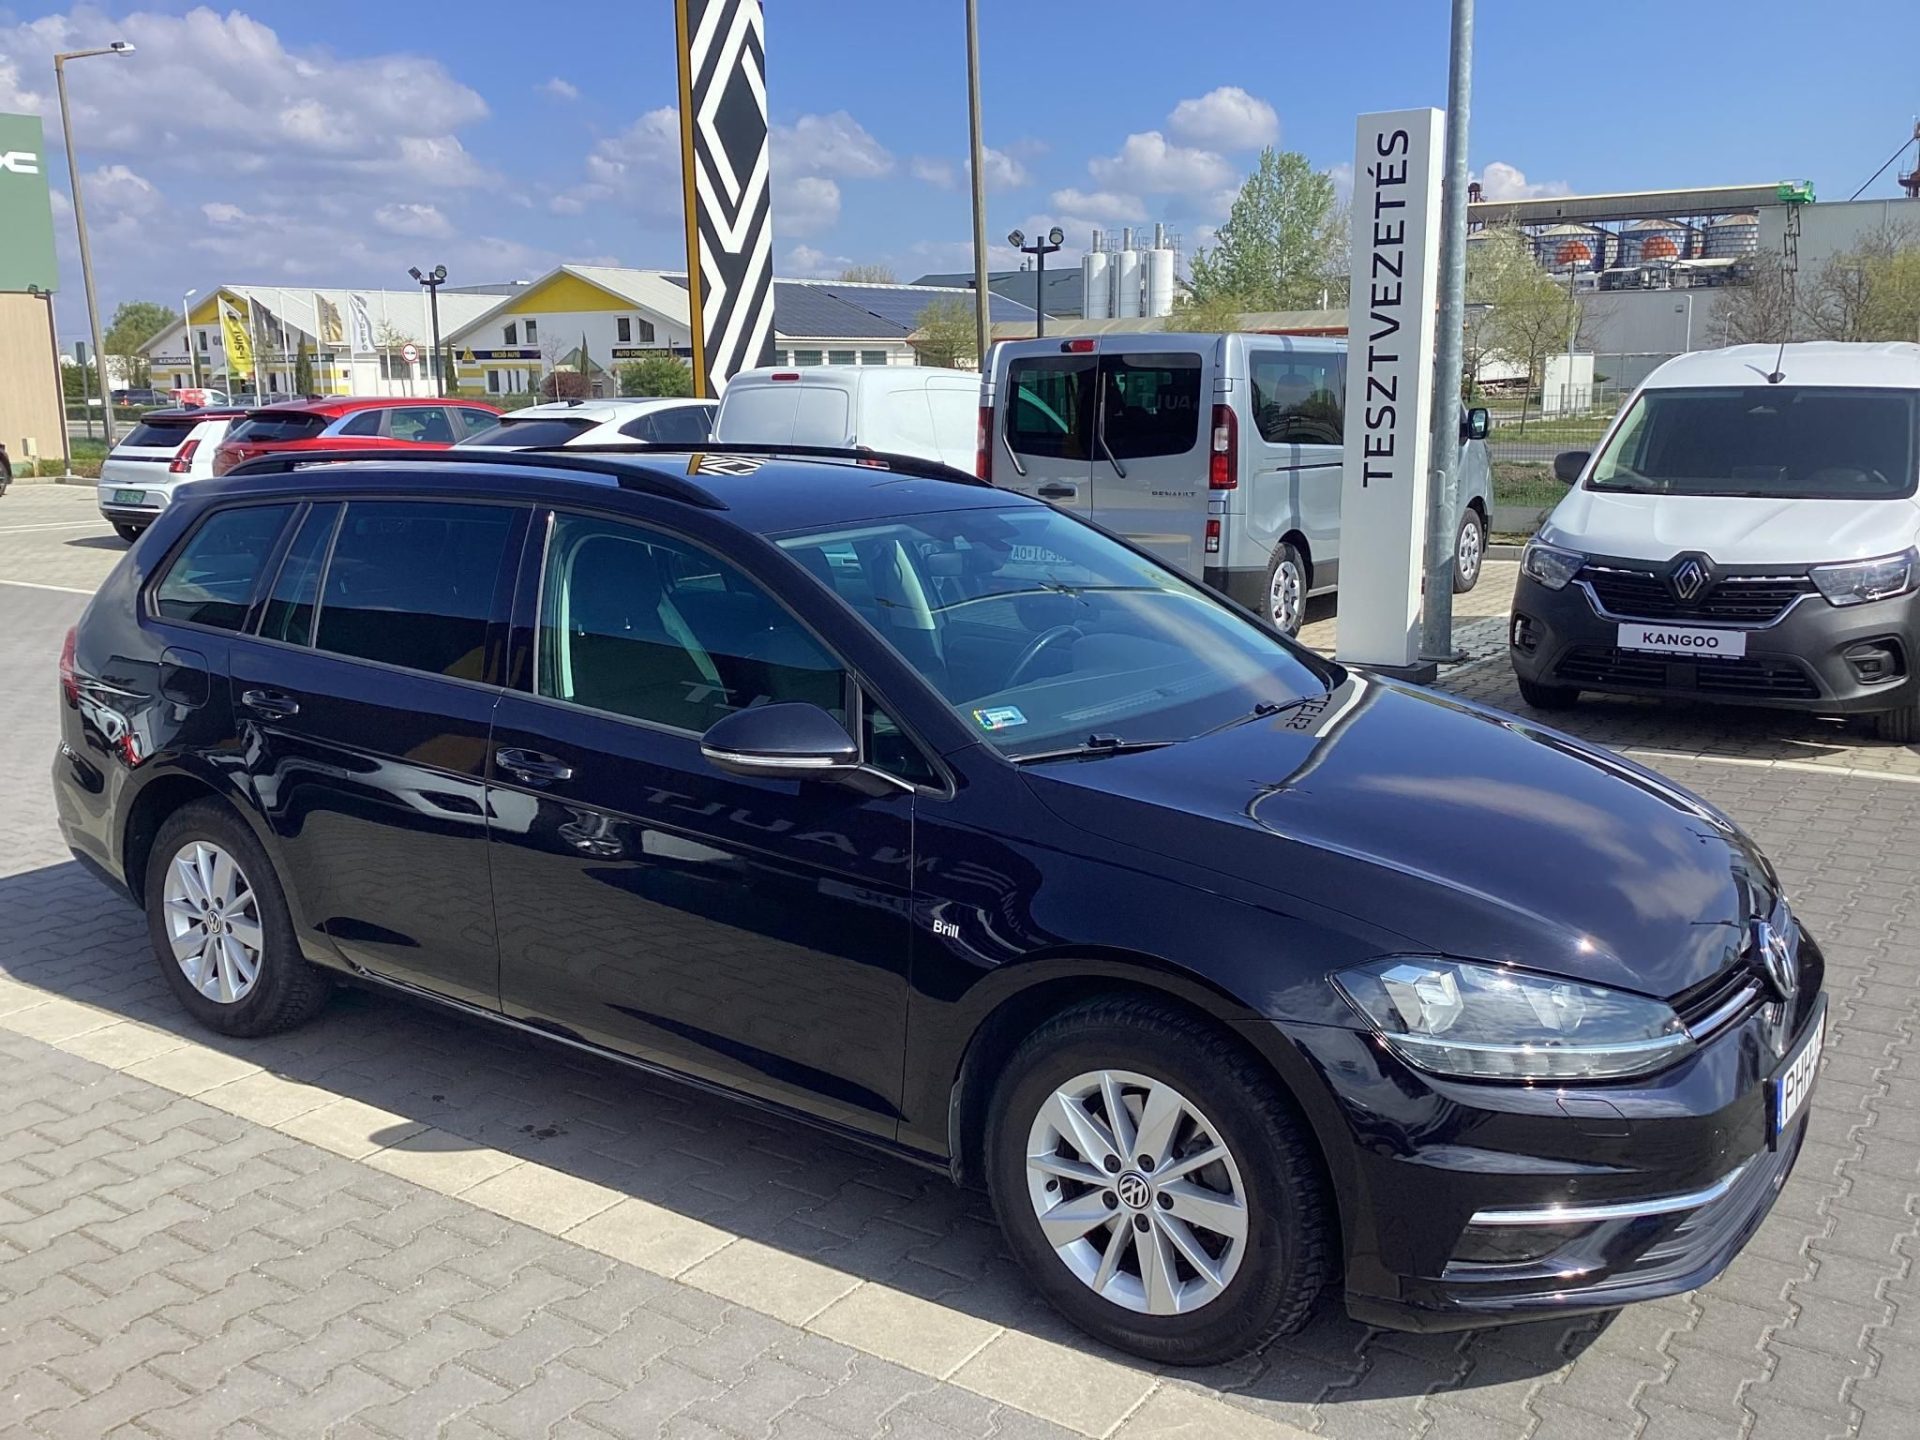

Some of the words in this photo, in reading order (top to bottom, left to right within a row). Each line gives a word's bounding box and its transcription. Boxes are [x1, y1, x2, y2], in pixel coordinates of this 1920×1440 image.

[1362, 128, 1409, 488] TESZTVEZETÉS
[1643, 632, 1719, 648] KANGOO
[933, 919, 959, 938] Brill
